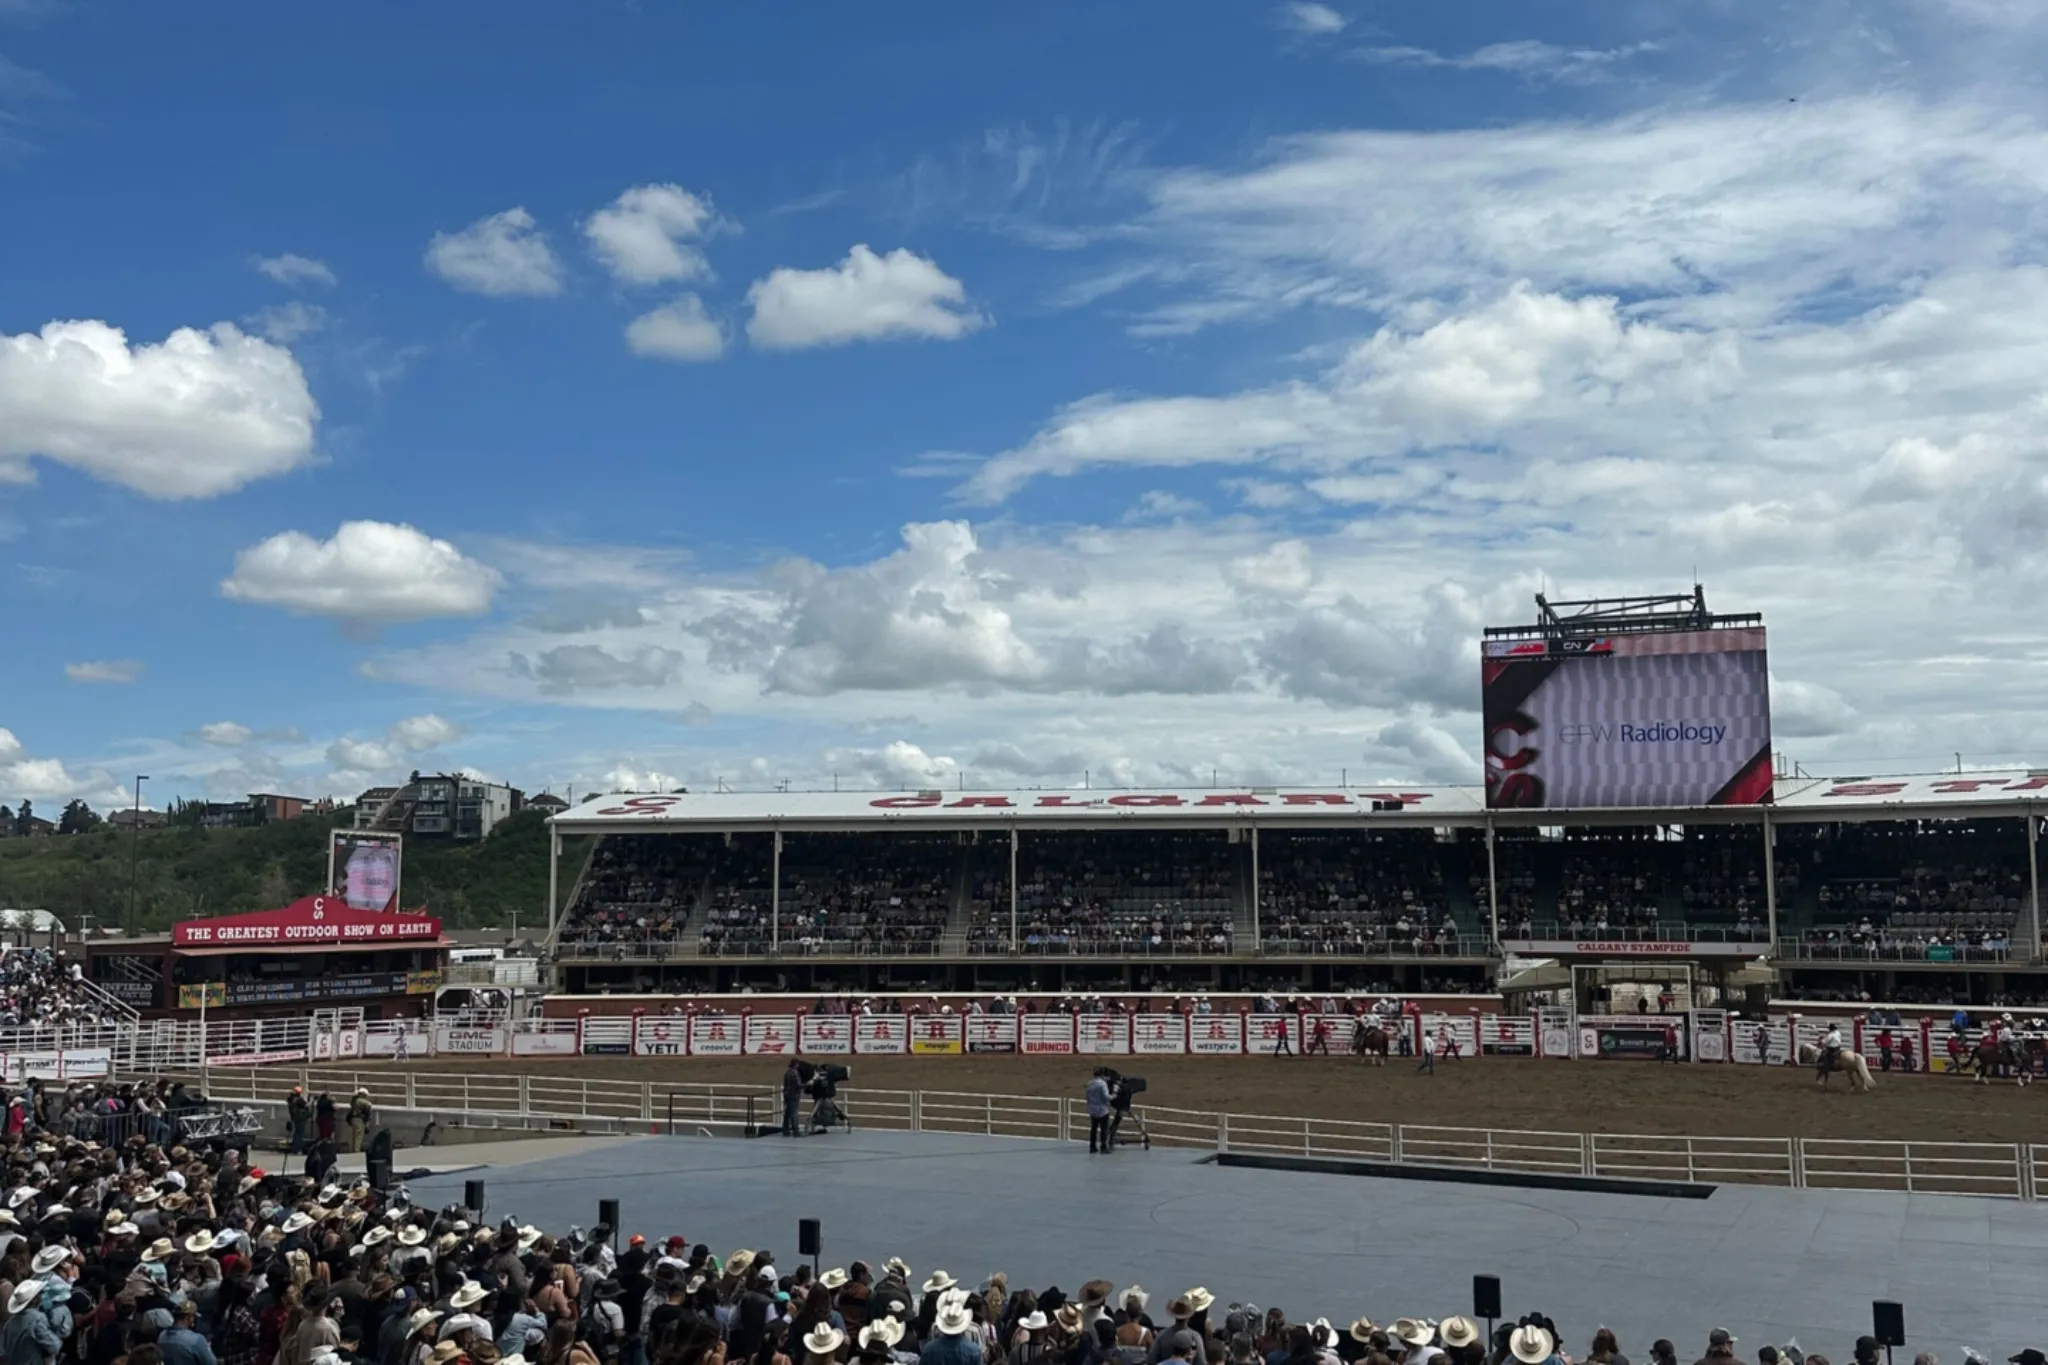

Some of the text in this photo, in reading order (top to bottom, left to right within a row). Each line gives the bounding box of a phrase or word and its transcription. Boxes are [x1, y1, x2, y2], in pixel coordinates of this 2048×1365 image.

[1563, 641, 1581, 650] CN
[1620, 721, 1727, 745] Radiology
[868, 792, 1434, 808] CALGARY
[186, 922, 432, 940] THE GREATEST OUTDOOR SHOW ON EARTH
[1576, 943, 1691, 952] CALGARY STAMPEDE
[100, 982, 152, 991] INFIELD
[449, 1031, 493, 1039] GMC
[448, 1040, 493, 1050] STADIUM
[645, 1043, 679, 1054] YETI
[1026, 1042, 1070, 1052] BURNCO
